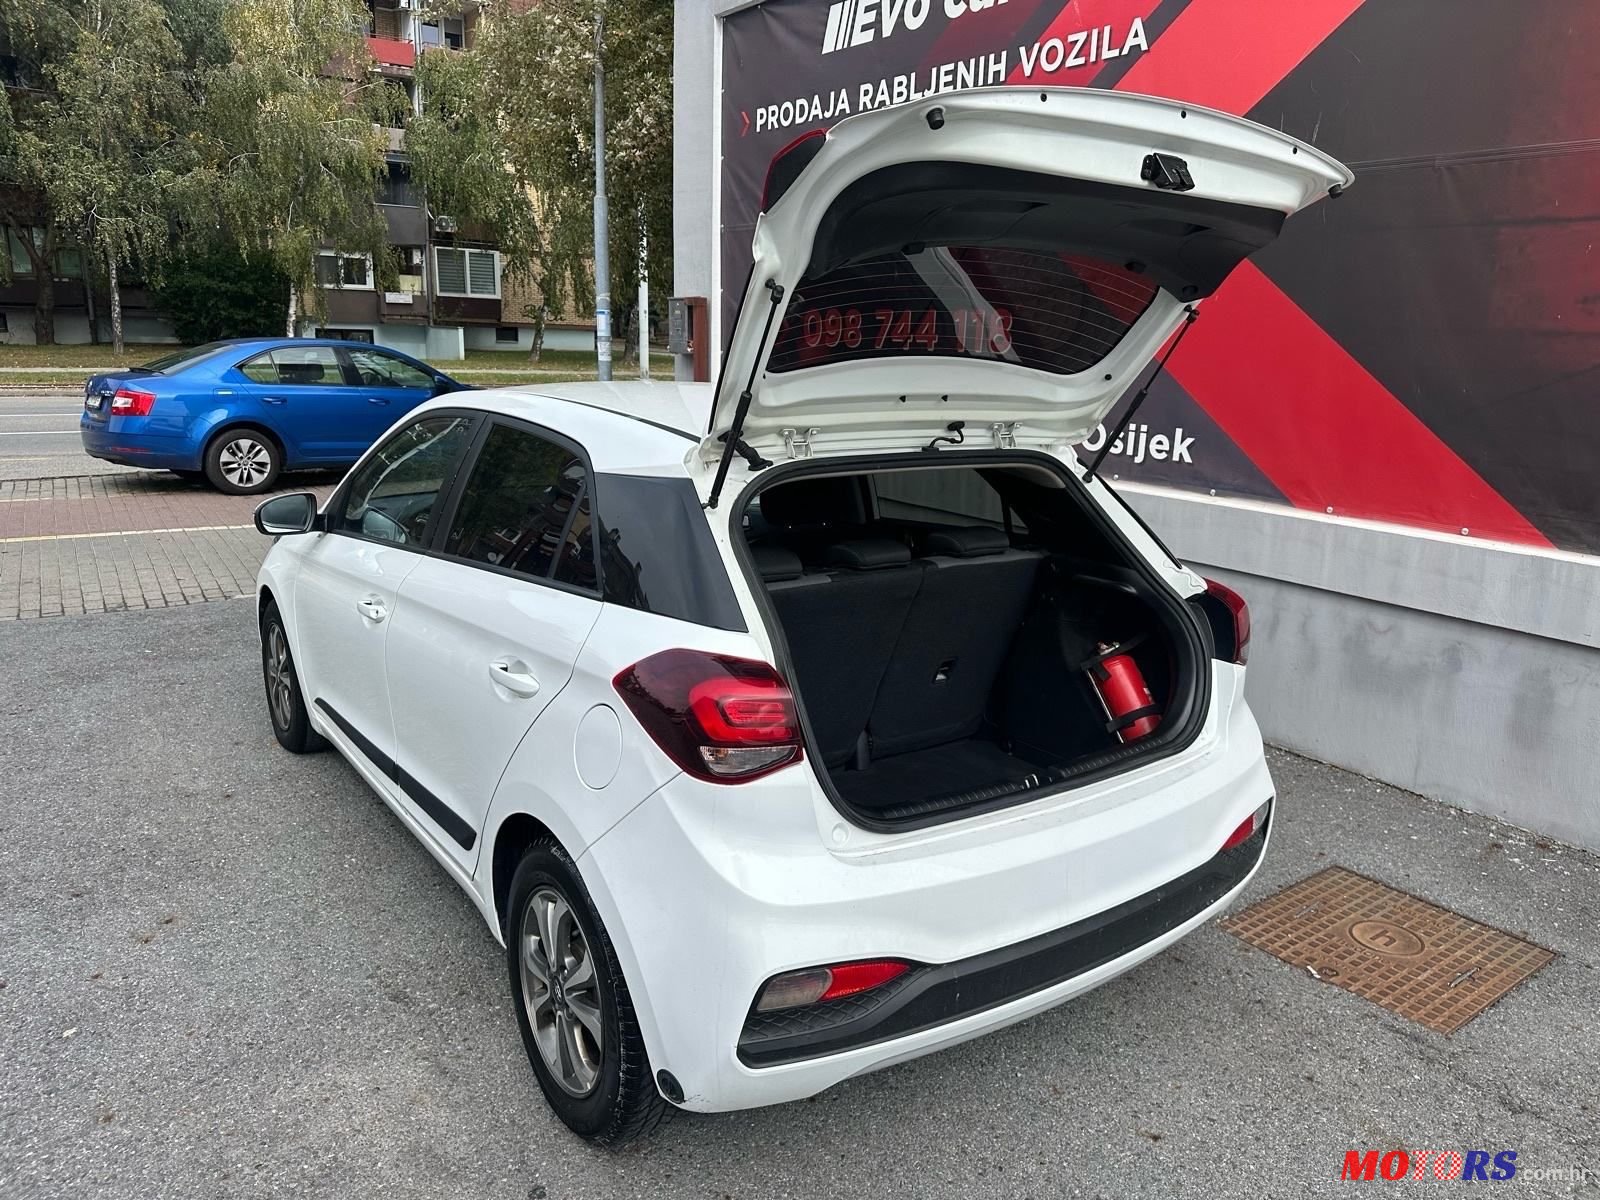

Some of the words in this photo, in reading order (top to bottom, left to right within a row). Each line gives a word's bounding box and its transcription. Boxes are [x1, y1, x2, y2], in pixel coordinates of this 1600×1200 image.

[756, 88, 850, 132] PRODAJA
[858, 50, 1007, 111] RABLJENIH
[1019, 17, 1149, 77] VOZILA
[803, 307, 862, 348] 098
[874, 308, 938, 351] 744
